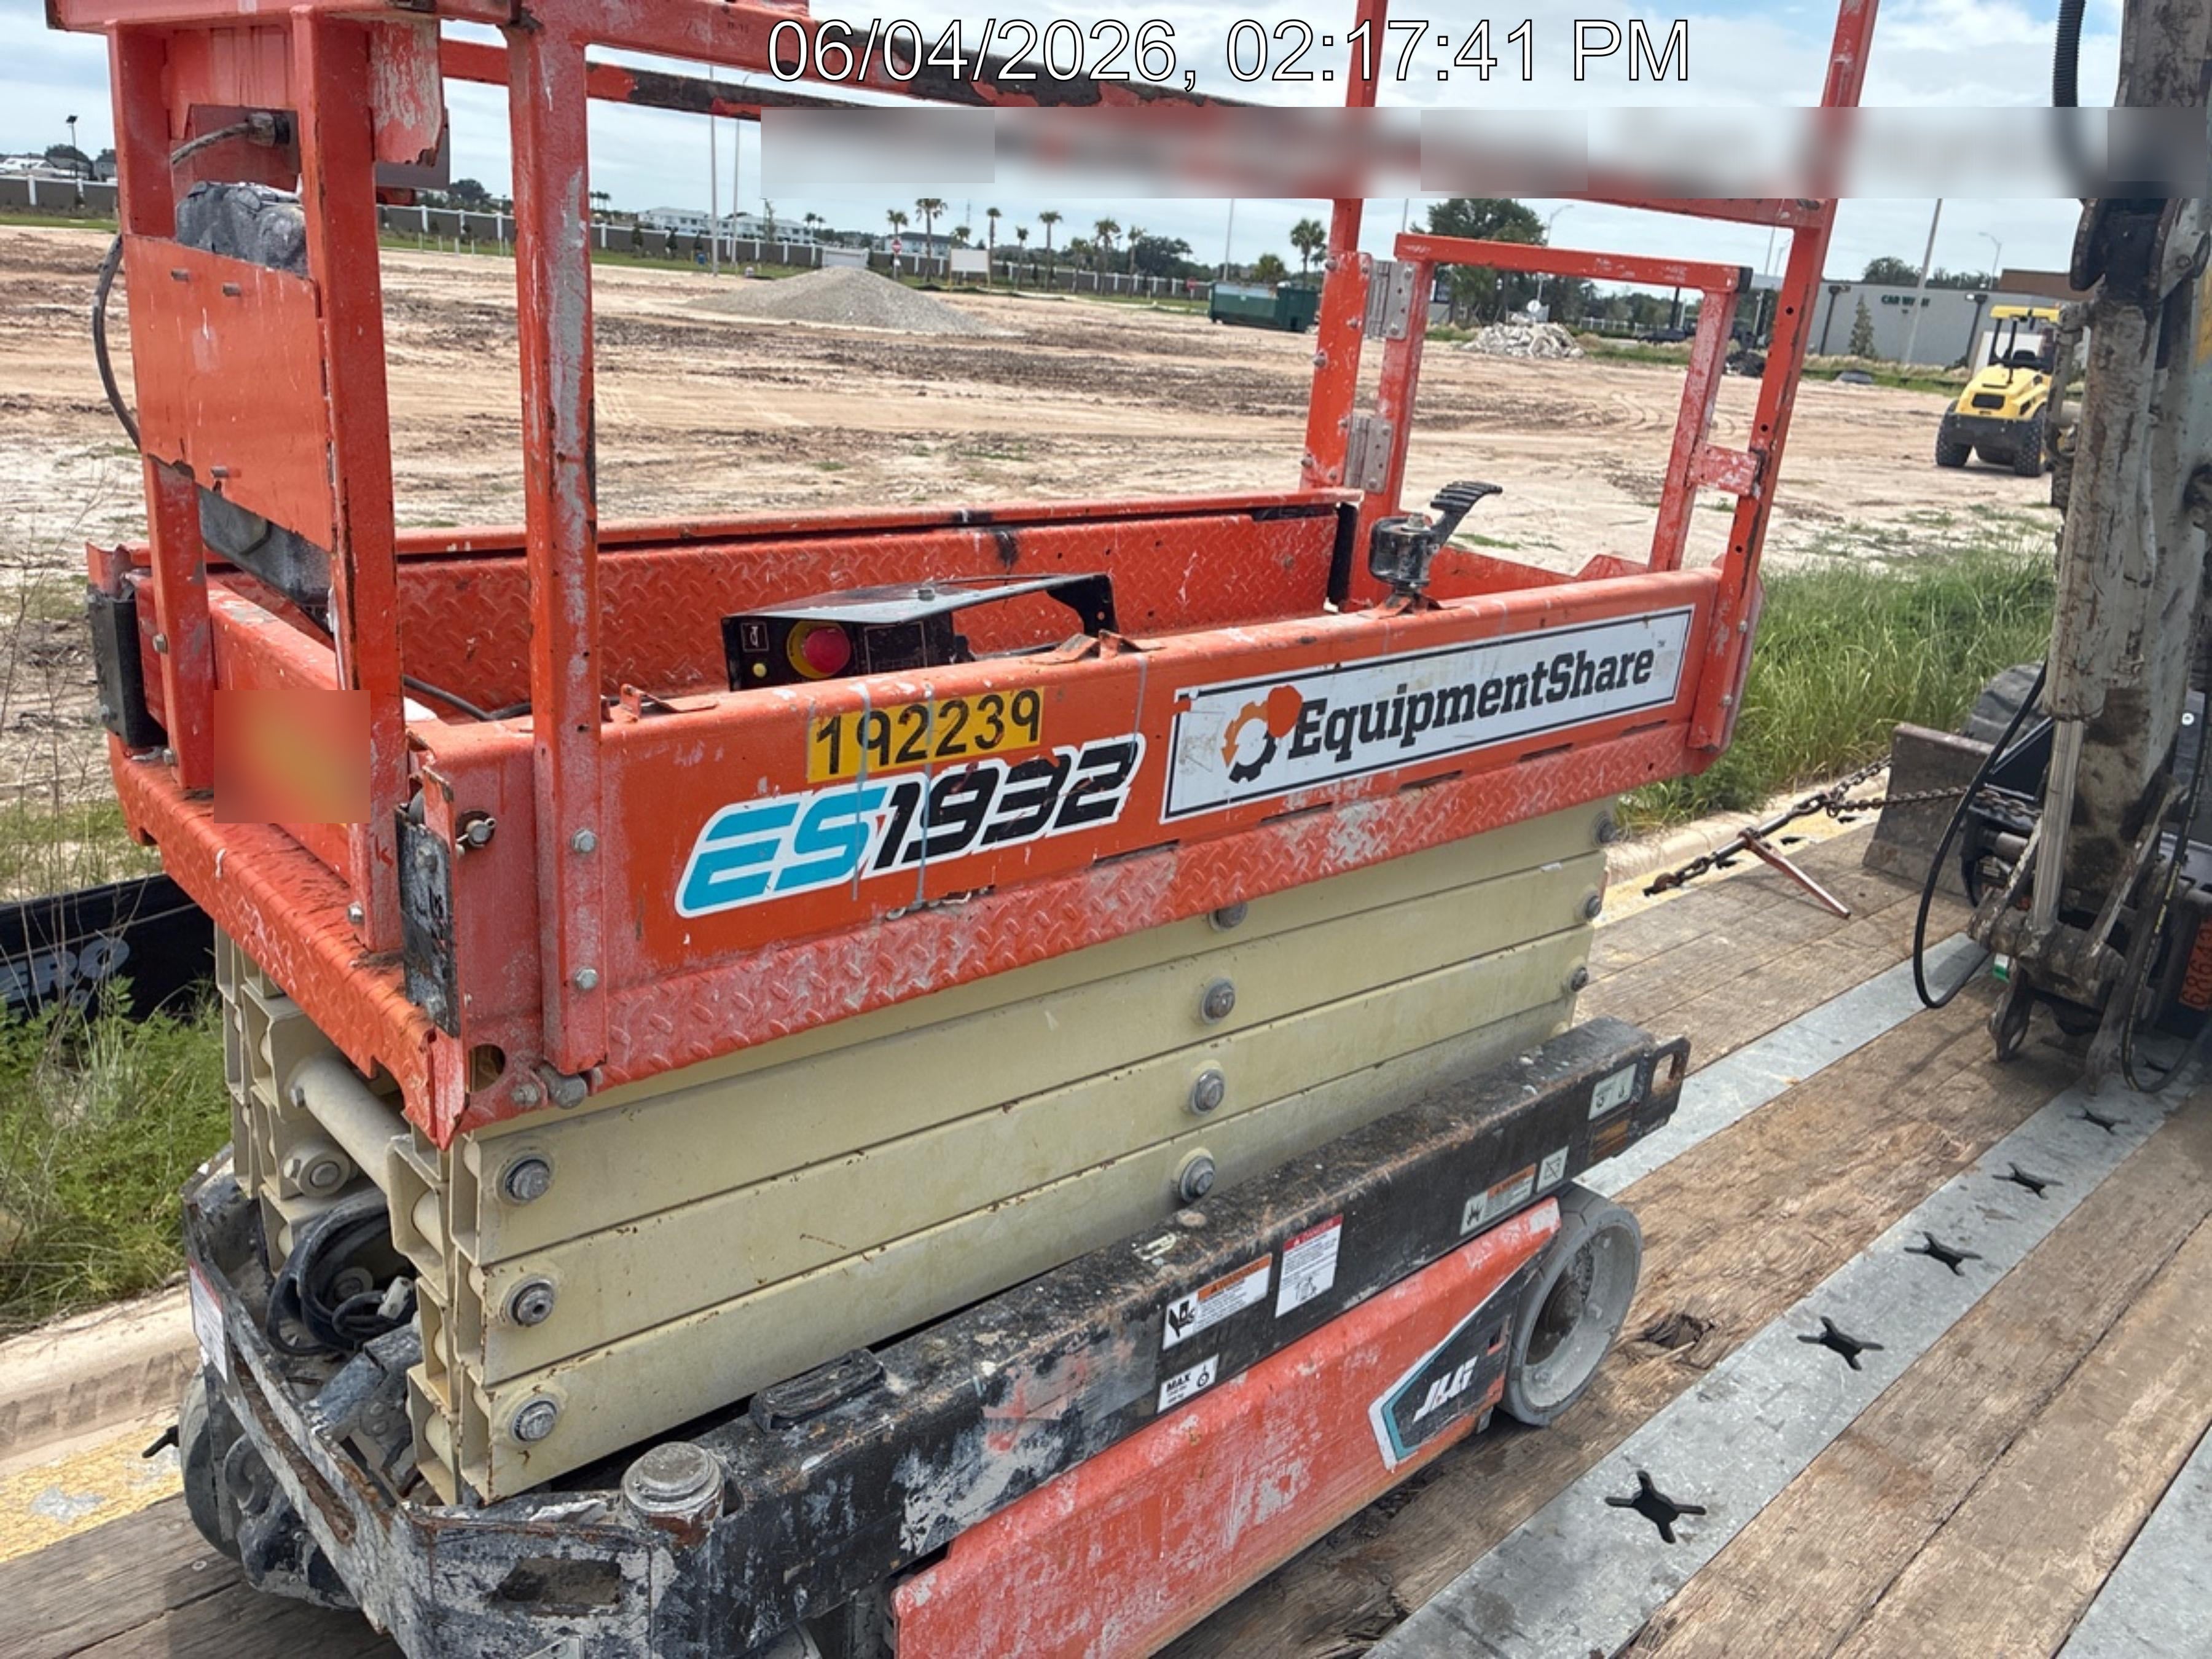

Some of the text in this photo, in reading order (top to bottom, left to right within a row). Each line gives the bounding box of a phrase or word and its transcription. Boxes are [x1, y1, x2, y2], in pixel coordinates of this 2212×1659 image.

[1881, 294, 1900, 305] CAR
[817, 688, 1041, 775] 192239
[1288, 647, 1655, 761] EquipmentShare
[680, 737, 1142, 913] ES1932
[1166, 1372, 1191, 1392] MAX
[1412, 1355, 1478, 1424] JLG
